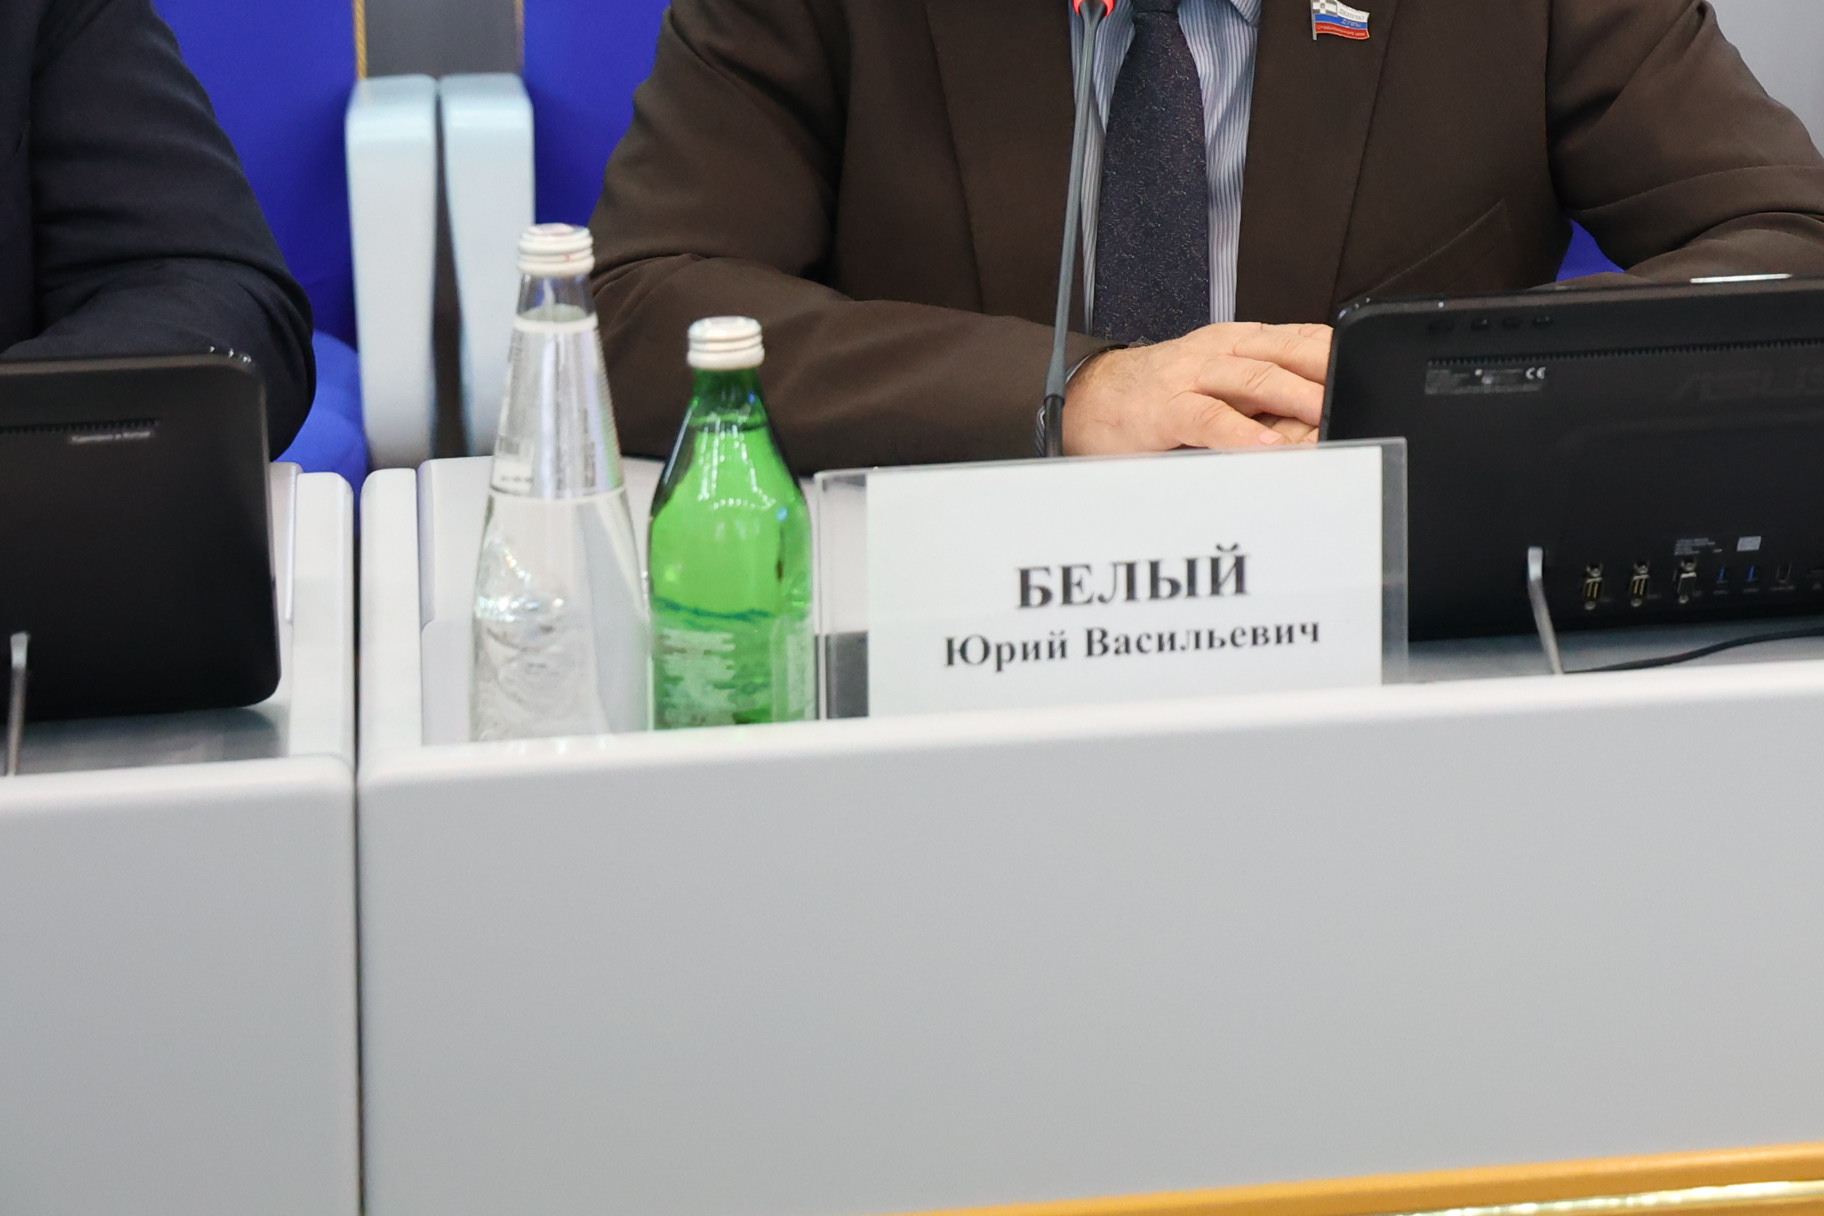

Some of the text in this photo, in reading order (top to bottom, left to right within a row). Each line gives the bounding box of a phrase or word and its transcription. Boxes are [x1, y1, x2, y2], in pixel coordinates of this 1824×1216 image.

[1016, 543, 1249, 610] БЕЛЫЙ
[945, 621, 1321, 673] Юрий Васильевич
